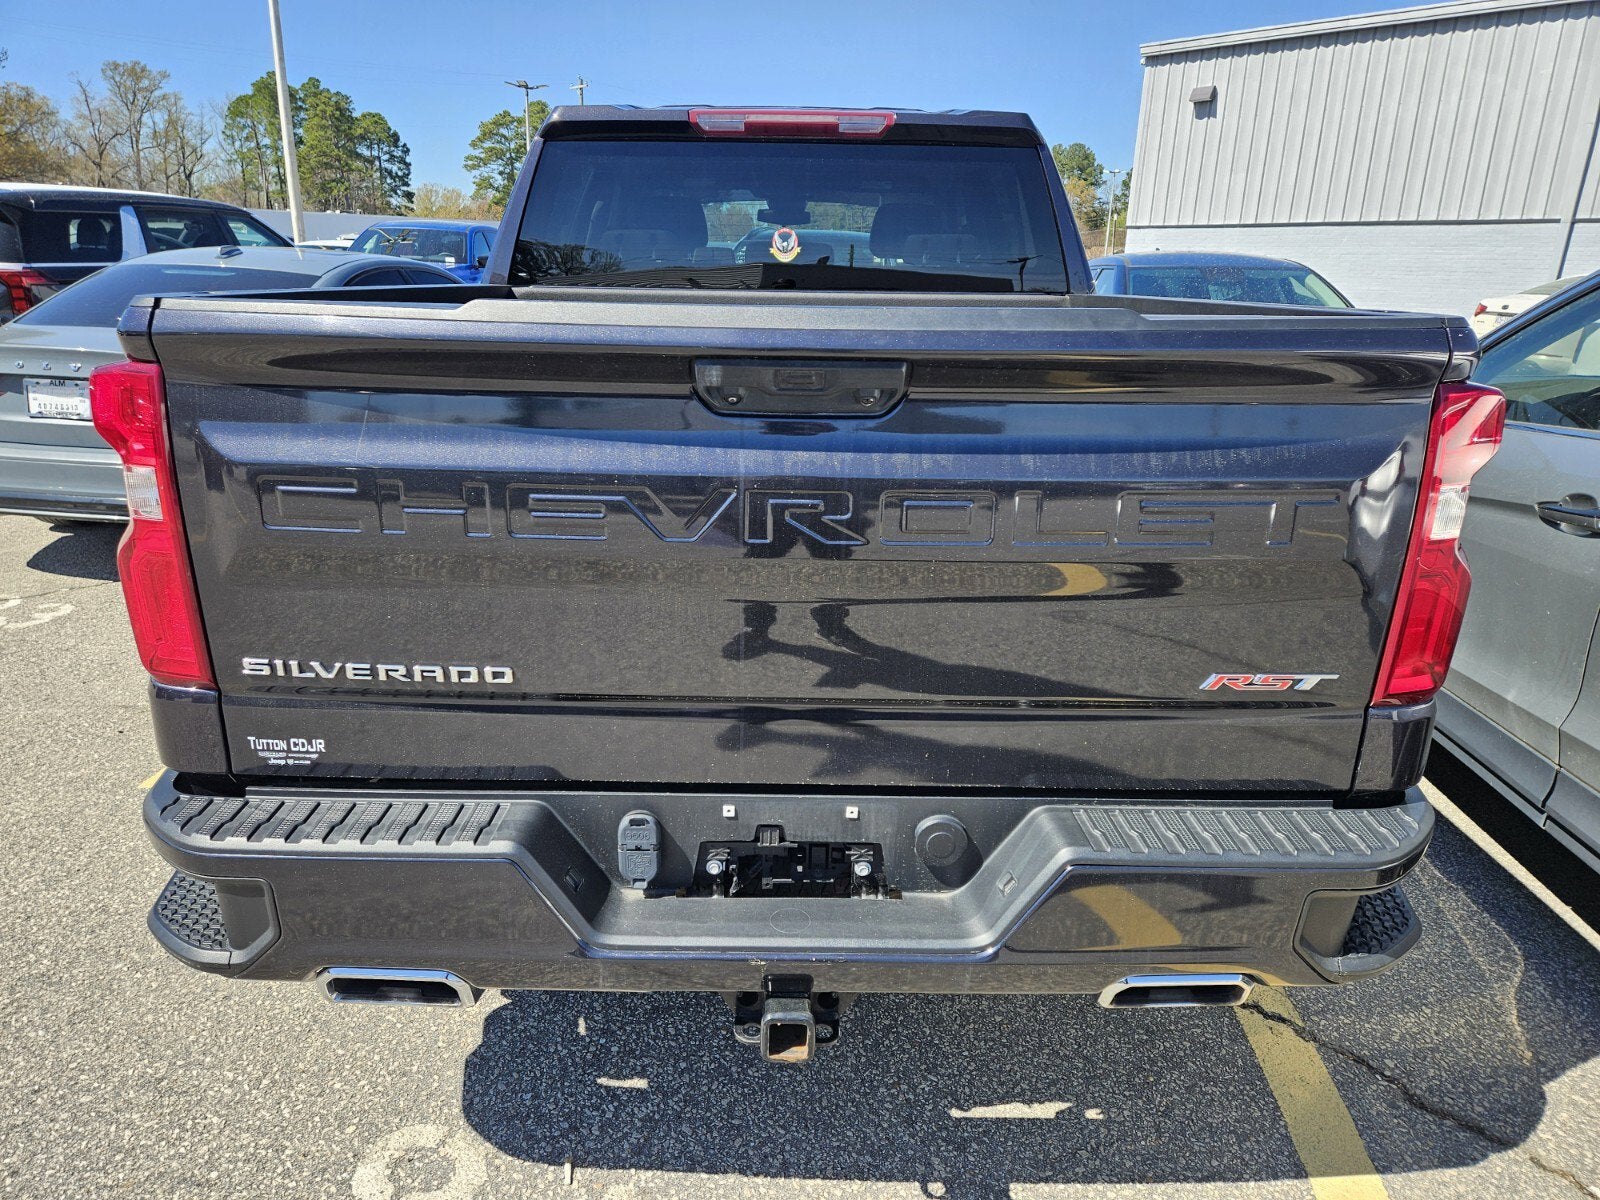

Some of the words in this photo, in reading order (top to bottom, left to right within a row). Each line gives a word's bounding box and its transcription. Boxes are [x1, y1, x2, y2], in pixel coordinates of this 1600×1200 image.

[49, 379, 66, 388] ALM
[256, 475, 1341, 546] CHEVROLET
[241, 656, 514, 684] SILVERADO
[1199, 673, 1340, 690] RST
[290, 738, 326, 752] CDJR
